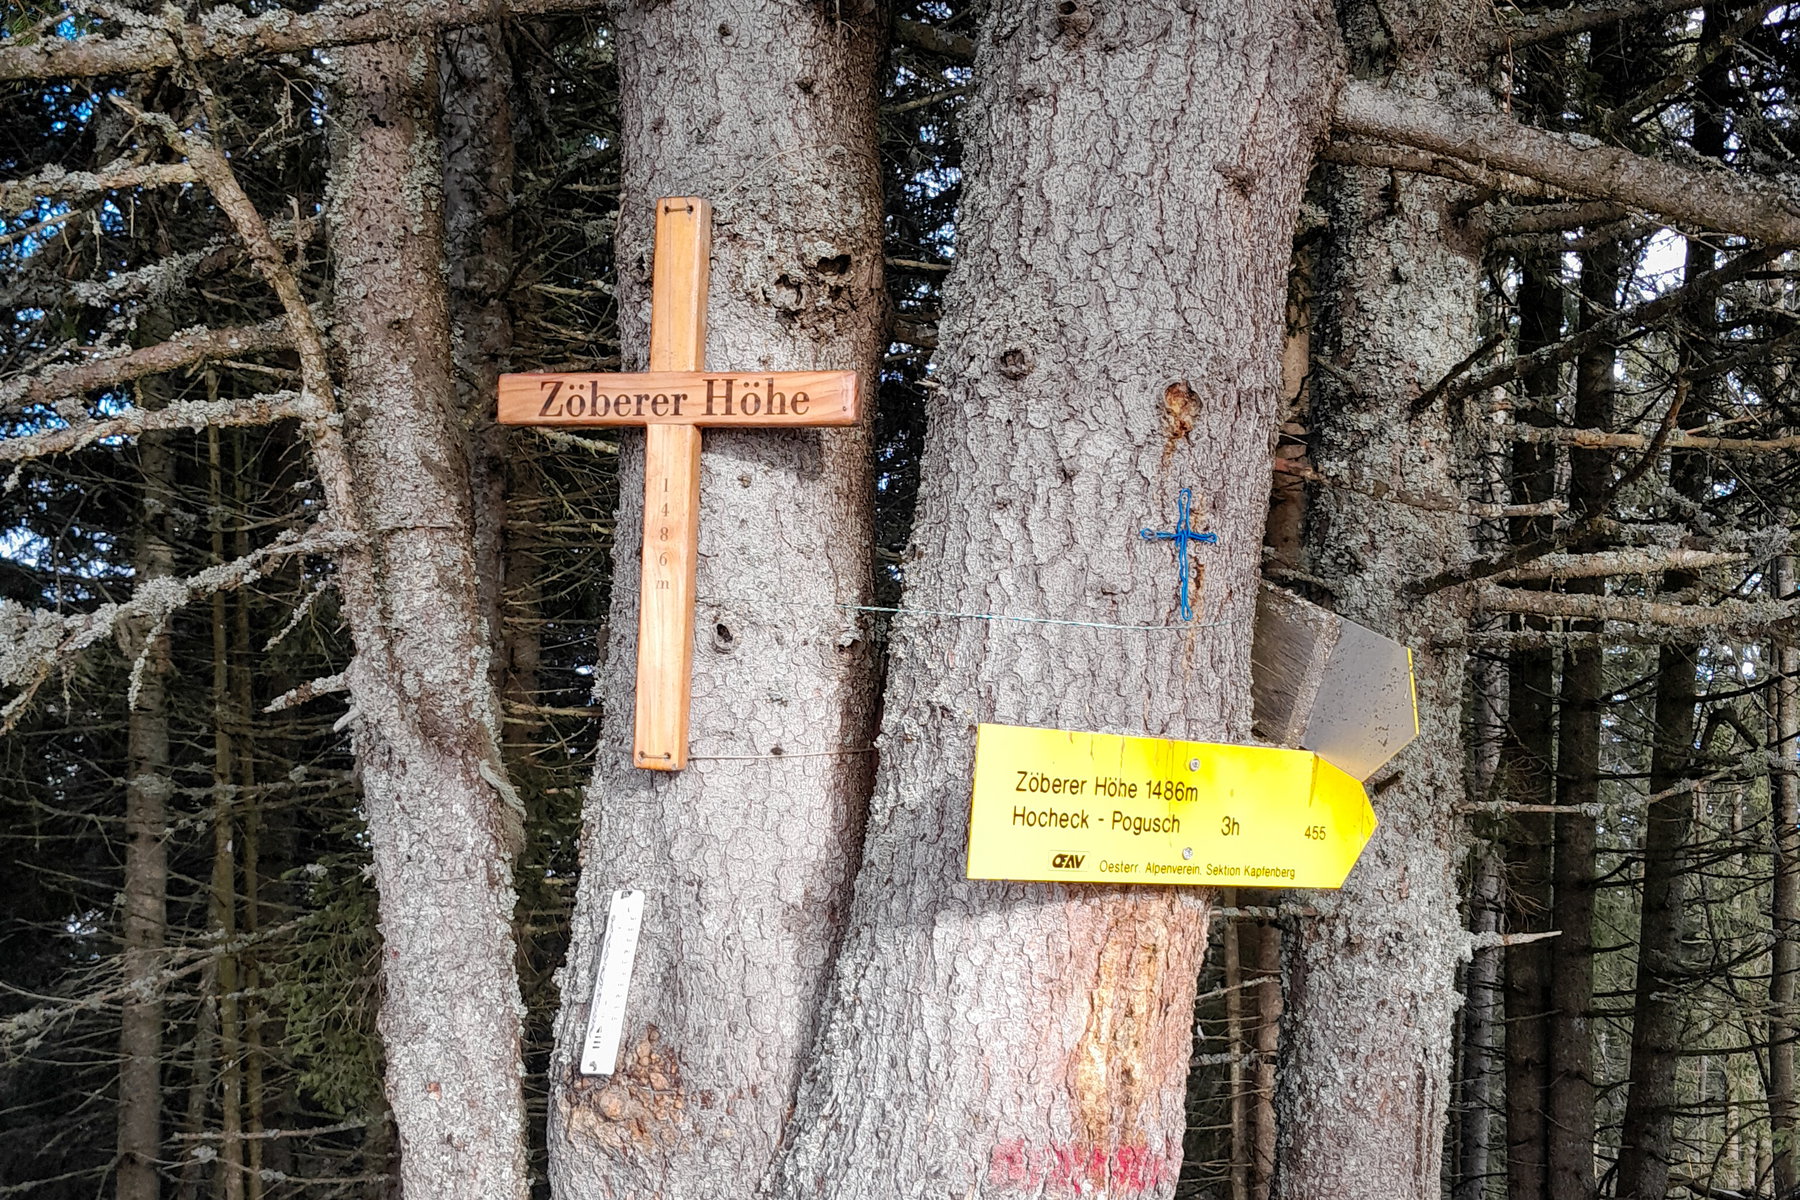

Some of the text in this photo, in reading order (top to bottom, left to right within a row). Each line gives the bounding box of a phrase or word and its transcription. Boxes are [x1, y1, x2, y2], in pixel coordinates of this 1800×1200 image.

[538, 377, 810, 418] Zöberer Höhe
[1015, 770, 1198, 802] Zöberer Höhe 1486m
[1012, 805, 1090, 830] Hocheck
[1111, 810, 1181, 836] Pogusch
[1221, 815, 1240, 836] 3h
[1304, 825, 1327, 841] 455
[1206, 863, 1241, 876] Sektion
[1243, 865, 1296, 880] Kapfenberg
